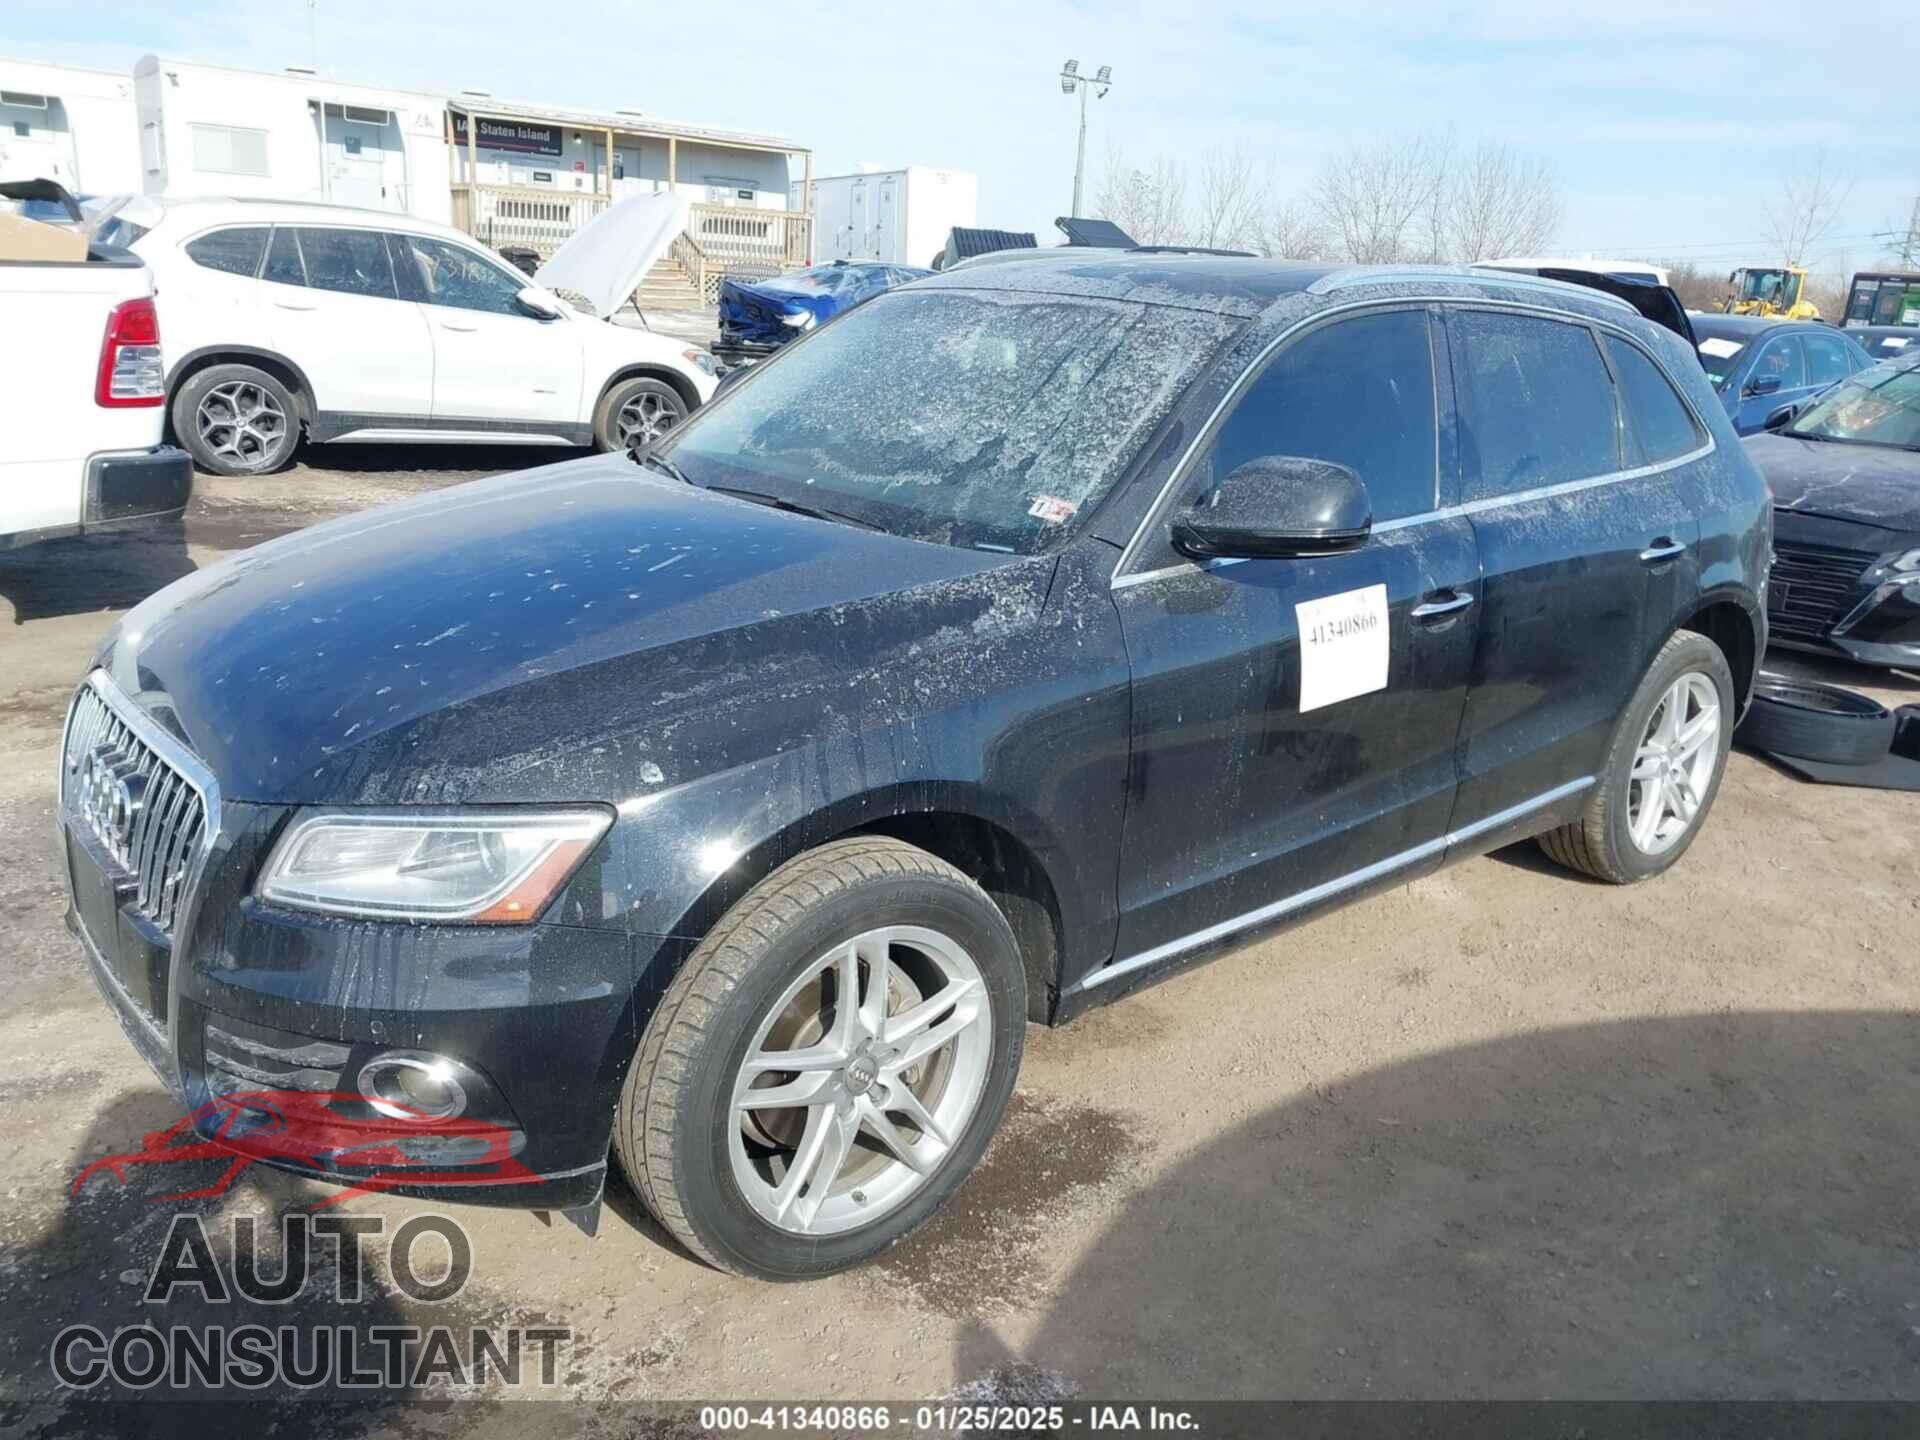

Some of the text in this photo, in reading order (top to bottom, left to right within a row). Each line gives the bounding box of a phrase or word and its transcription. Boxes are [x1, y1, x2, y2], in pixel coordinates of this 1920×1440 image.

[480, 122, 516, 137] Staten
[518, 126, 550, 142] Island
[1310, 611, 1378, 646] 41340866
